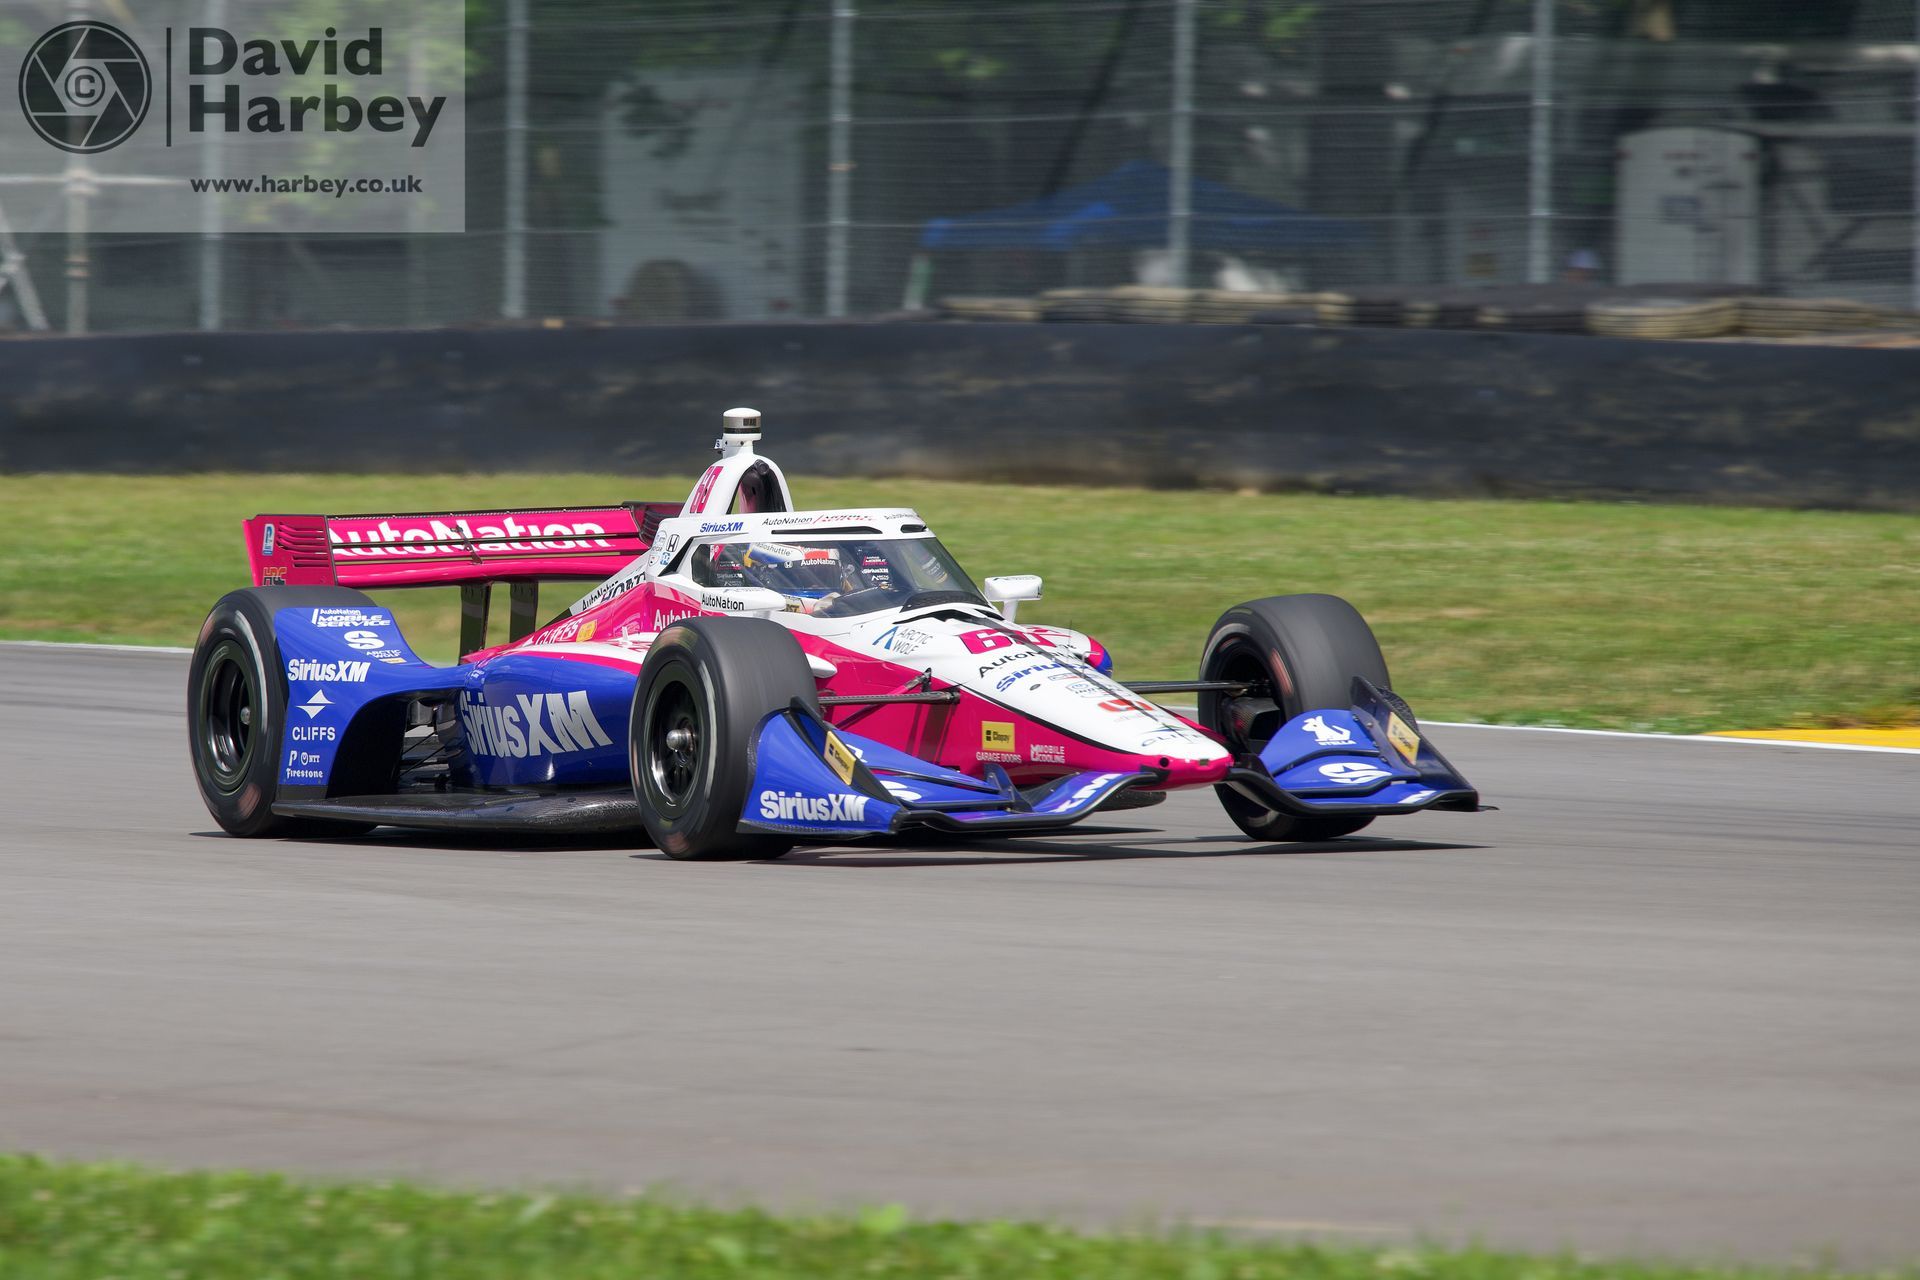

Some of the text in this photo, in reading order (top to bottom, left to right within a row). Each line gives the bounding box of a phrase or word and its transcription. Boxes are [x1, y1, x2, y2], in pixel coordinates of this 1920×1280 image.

[700, 522, 744, 533] SiriusXM
[762, 517, 813, 526] AutoNation
[801, 558, 836, 567] AutoNation
[701, 593, 745, 611] AutoNation
[320, 608, 361, 616] AutoNation
[316, 620, 391, 628] SERVICE
[318, 615, 383, 623] MOBILE
[897, 628, 933, 645] ARCTIC
[894, 639, 919, 656] WOLF
[288, 658, 371, 683] SiriusXM
[460, 690, 614, 759] SiriusXM
[292, 726, 336, 742] CLIFFS
[976, 751, 1022, 764] GARAGE DOORS
[286, 767, 323, 779] Firestone
[760, 790, 869, 823] SiriusXM
